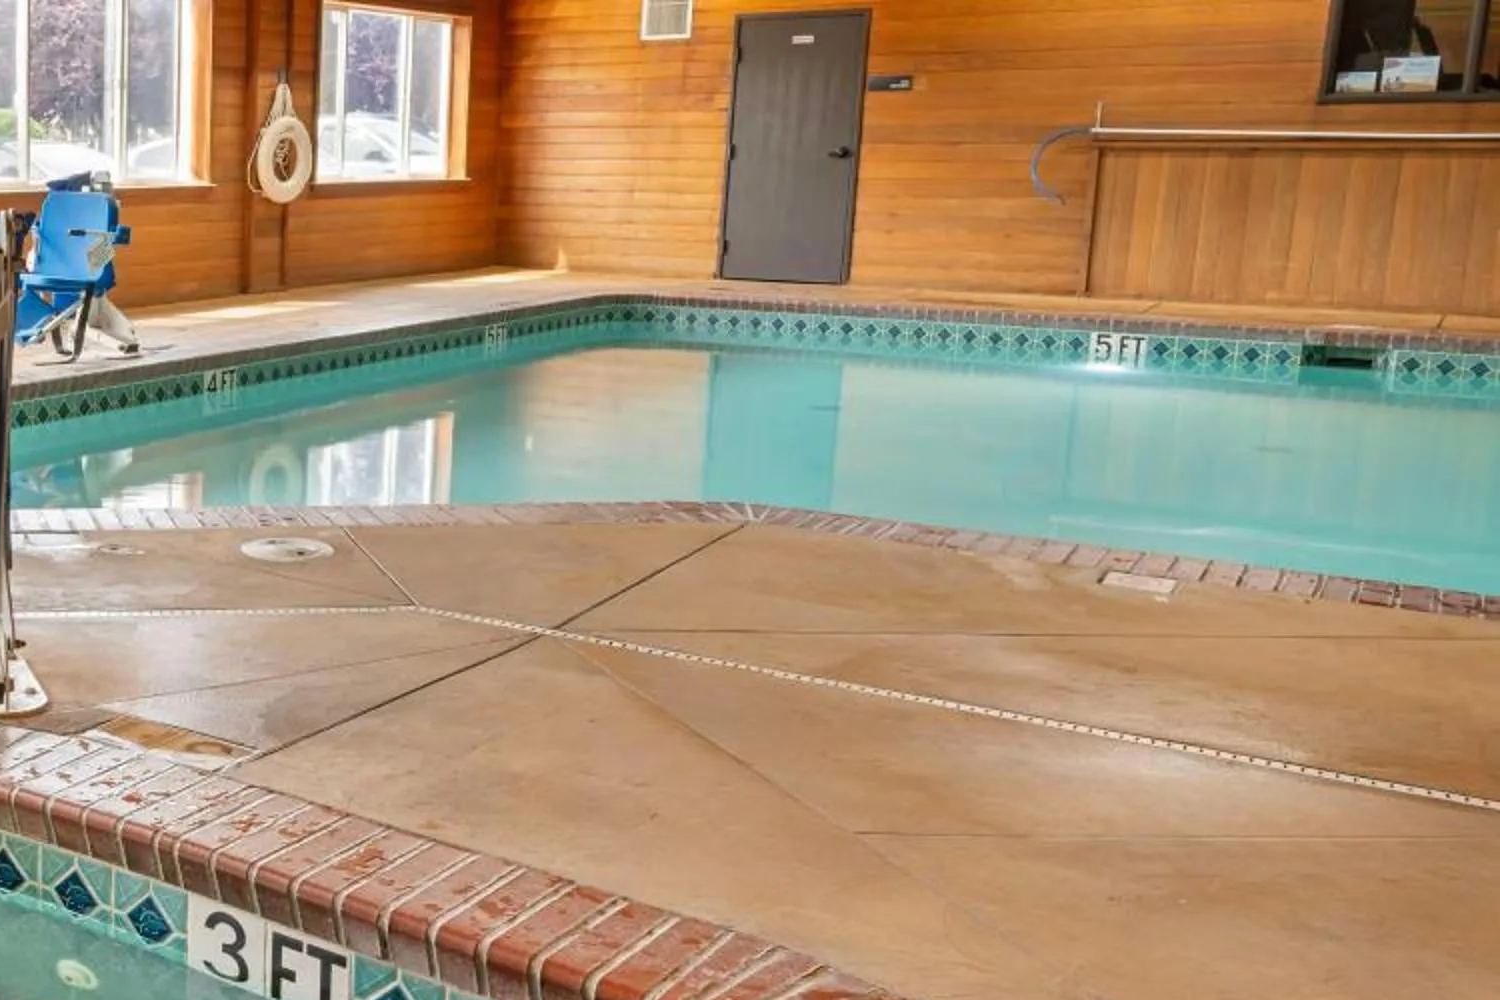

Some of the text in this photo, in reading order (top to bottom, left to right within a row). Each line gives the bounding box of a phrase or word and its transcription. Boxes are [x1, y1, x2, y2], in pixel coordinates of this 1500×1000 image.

[1095, 333, 1146, 361] 5 FT
[207, 369, 237, 392] 4 FT
[203, 911, 249, 983] 3
